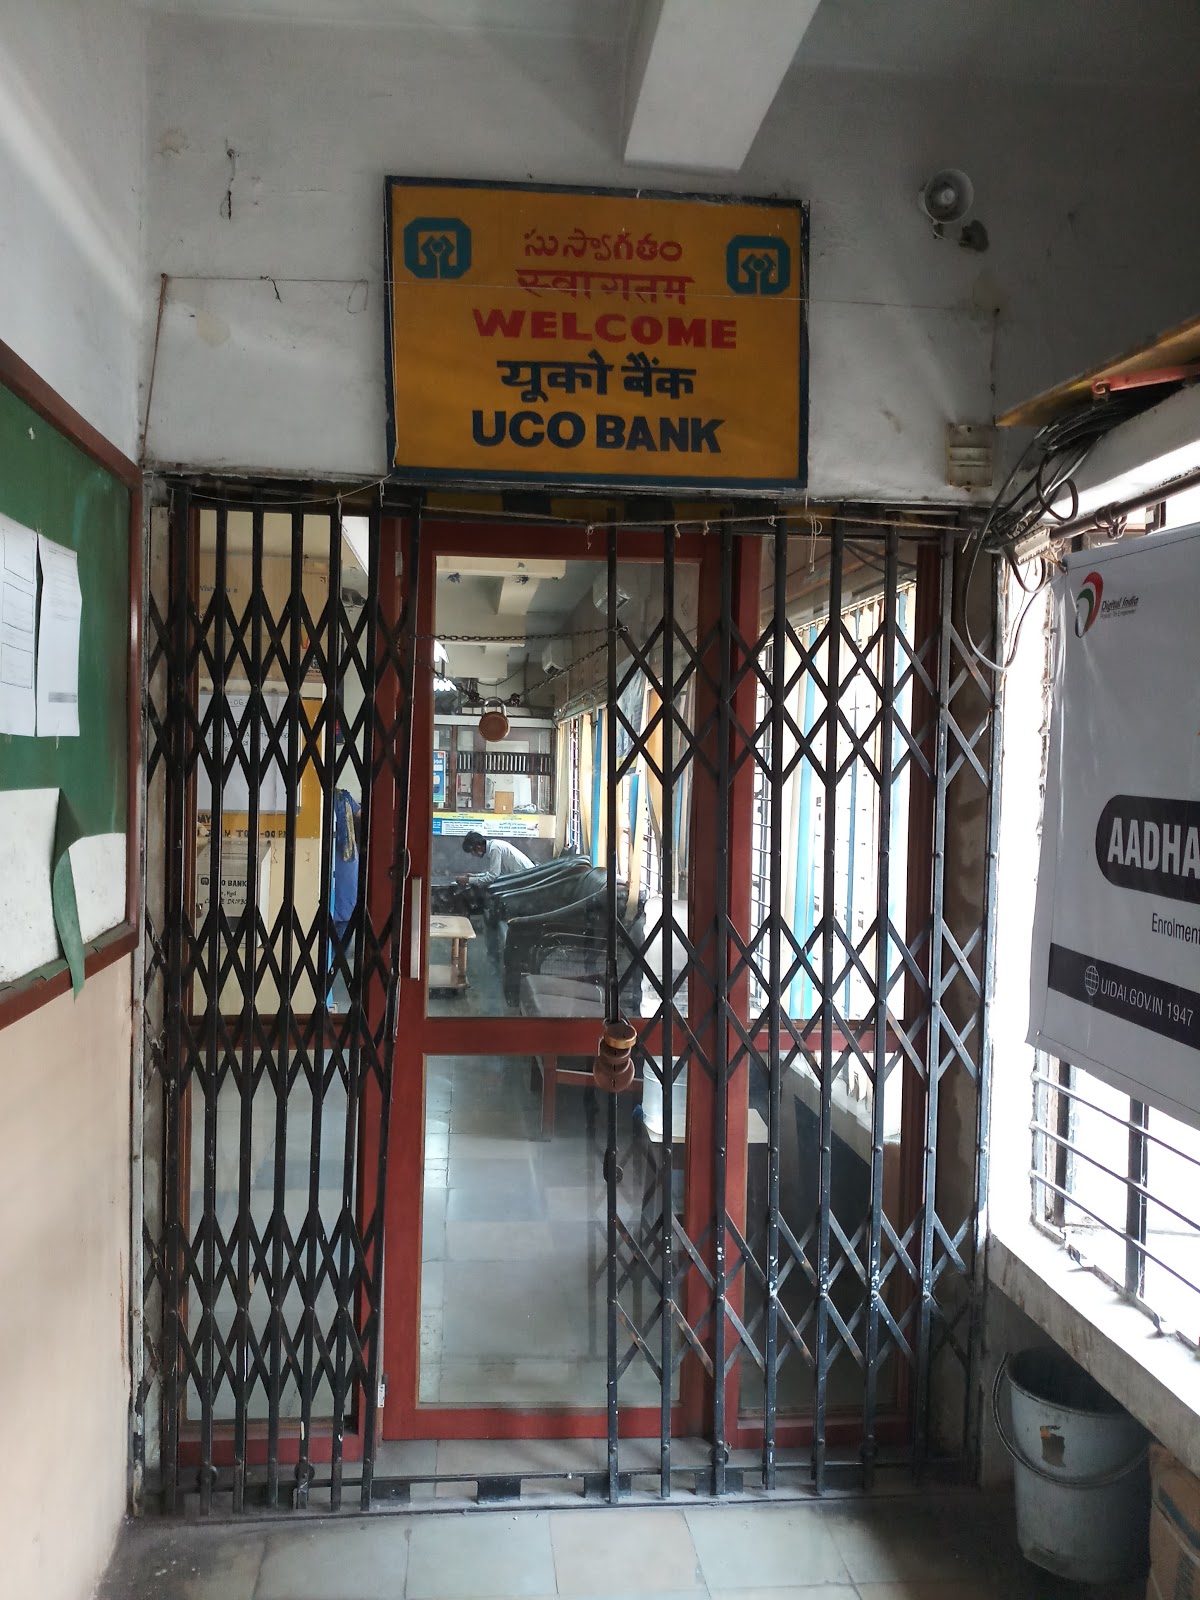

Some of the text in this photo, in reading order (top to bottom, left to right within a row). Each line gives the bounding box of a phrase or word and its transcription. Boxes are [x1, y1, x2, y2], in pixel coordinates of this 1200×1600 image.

[472, 308, 737, 349] WELCOME
[496, 348, 697, 403] यूको बैंक
[472, 409, 726, 453] UCO BANK
[1101, 978, 1194, 1026] UIDAI.GOV.IN 1947
